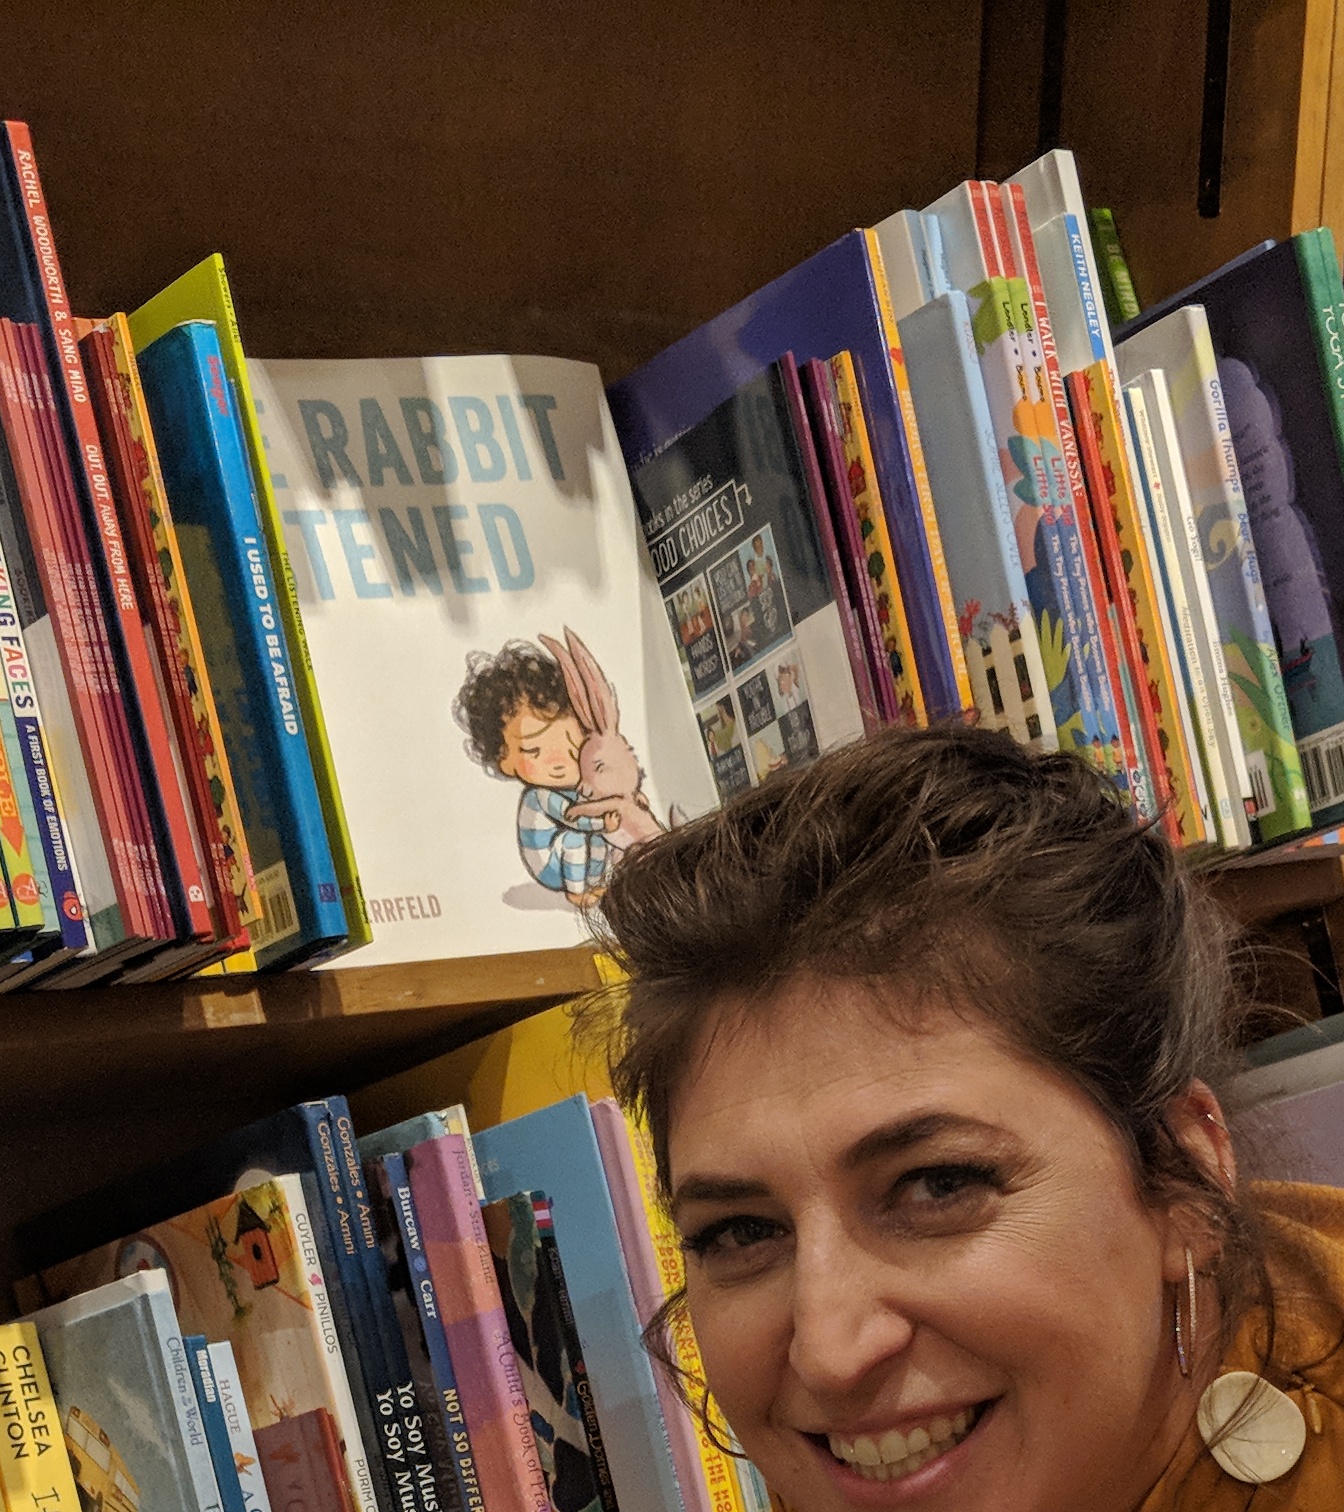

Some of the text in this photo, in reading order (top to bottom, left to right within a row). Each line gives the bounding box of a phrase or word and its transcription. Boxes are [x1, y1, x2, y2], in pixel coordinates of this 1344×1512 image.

[17, 148, 78, 364] RACHEL WOODWORTH SANG
[1072, 233, 1102, 338] KEITH NEGLEY
[1038, 317, 1057, 360] WALK
[1322, 305, 1344, 370] YOGA
[300, 393, 568, 492] RABBIT
[1209, 380, 1241, 493] Gorilla Thumps
[673, 491, 688, 515] the
[690, 474, 714, 501] series
[678, 494, 733, 558] CHOICES
[284, 502, 535, 602] TENED
[1, 636, 34, 709] FACES
[249, 551, 298, 736] USED TO BE AFRAID
[12, 1345, 52, 1457] CHELSEA
[405, 1413, 426, 1457] Soy
[385, 1422, 405, 1464] Soy
[454, 1431, 468, 1453] SO
